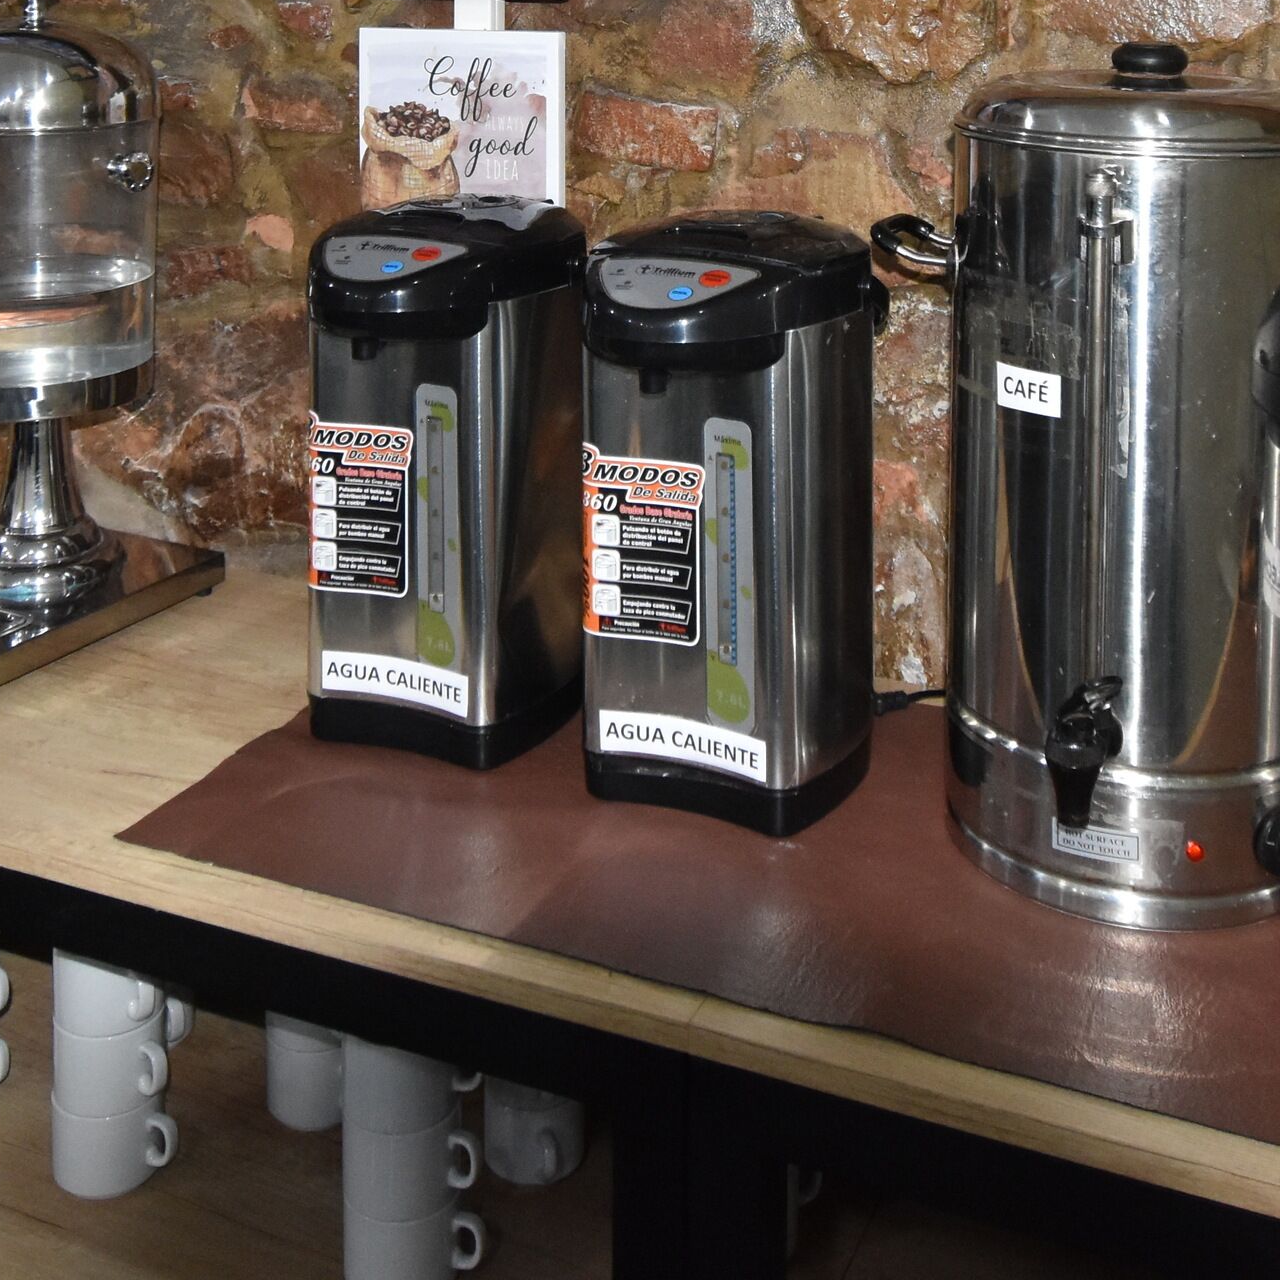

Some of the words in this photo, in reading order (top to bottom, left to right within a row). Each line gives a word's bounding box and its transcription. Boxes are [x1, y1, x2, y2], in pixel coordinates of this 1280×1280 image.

[424, 56, 517, 121] Coffee
[464, 116, 538, 177] good
[485, 158, 519, 181] IDEA
[372, 243, 410, 252] Trillium
[654, 267, 696, 279] Trillium
[1004, 376, 1048, 403] CAFÉ
[313, 427, 408, 451] MODOS
[310, 456, 334, 473] 60
[348, 450, 365, 459] De
[369, 452, 405, 463] Salida
[592, 463, 700, 488] MODOS
[633, 486, 651, 497] De
[655, 488, 696, 503] Salida
[622, 525, 649, 533] Pulsando
[667, 536, 683, 544] panel
[327, 662, 380, 682] AGUA
[386, 669, 461, 703] CALIENTE
[606, 722, 665, 744] AGUA
[672, 731, 758, 769] CALIENTE
[1062, 838, 1075, 846] DO
[1077, 841, 1095, 851] NOT
[1099, 846, 1130, 857] TOUCH
[1085, 833, 1124, 846] SURFACE
